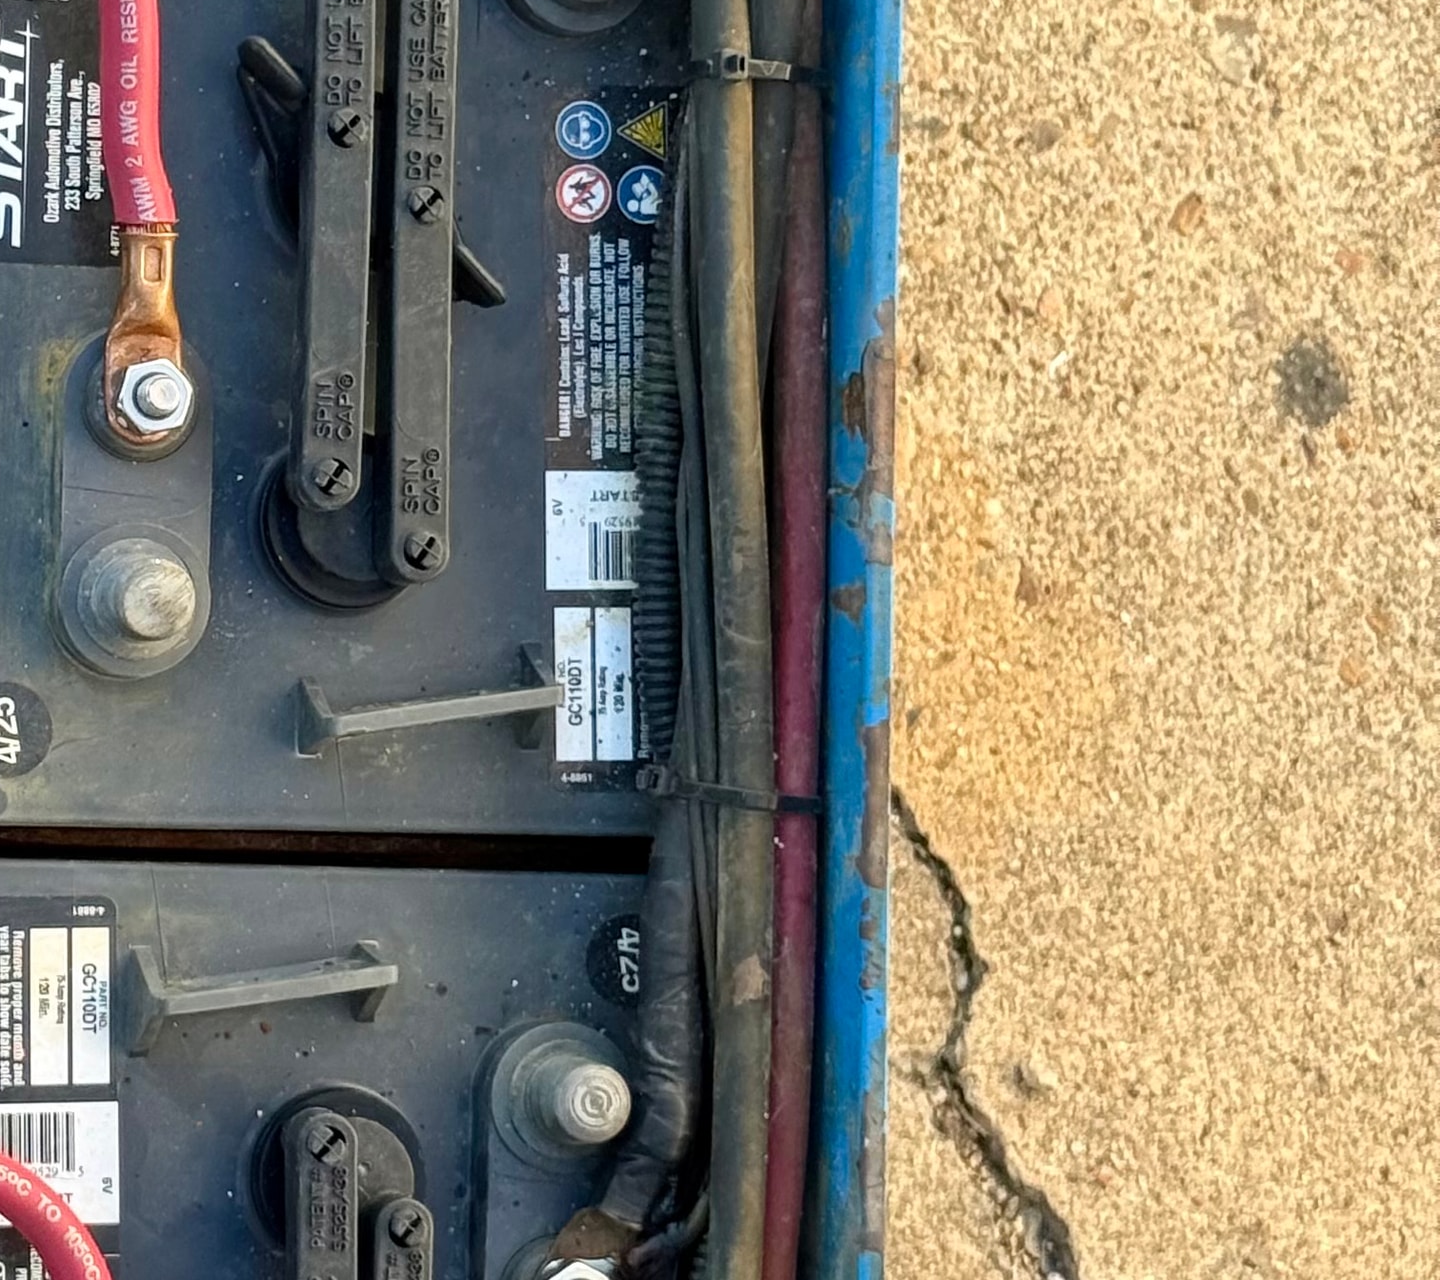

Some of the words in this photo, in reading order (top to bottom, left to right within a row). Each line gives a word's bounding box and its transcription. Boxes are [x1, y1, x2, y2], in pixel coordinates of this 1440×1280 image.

[119, 55, 138, 90] OIL
[45, 59, 65, 127] Distributors,
[66, 101, 83, 154] Patterson
[86, 118, 101, 138] MO
[120, 100, 140, 148] AWG
[44, 129, 62, 191] Automotive
[66, 156, 82, 188] South
[85, 141, 104, 200] Springfield
[125, 155, 143, 168] 2
[44, 192, 60, 223] Ozark
[66, 189, 81, 211] 233
[133, 177, 159, 221] AWM
[567, 656, 583, 726] GC110DT
[38, 977, 50, 995] 120
[82, 962, 97, 1034] GC110DT
[98, 980, 108, 1009] PART
[98, 1012, 108, 1031] NO.
[39, 1193, 62, 1222] TO
